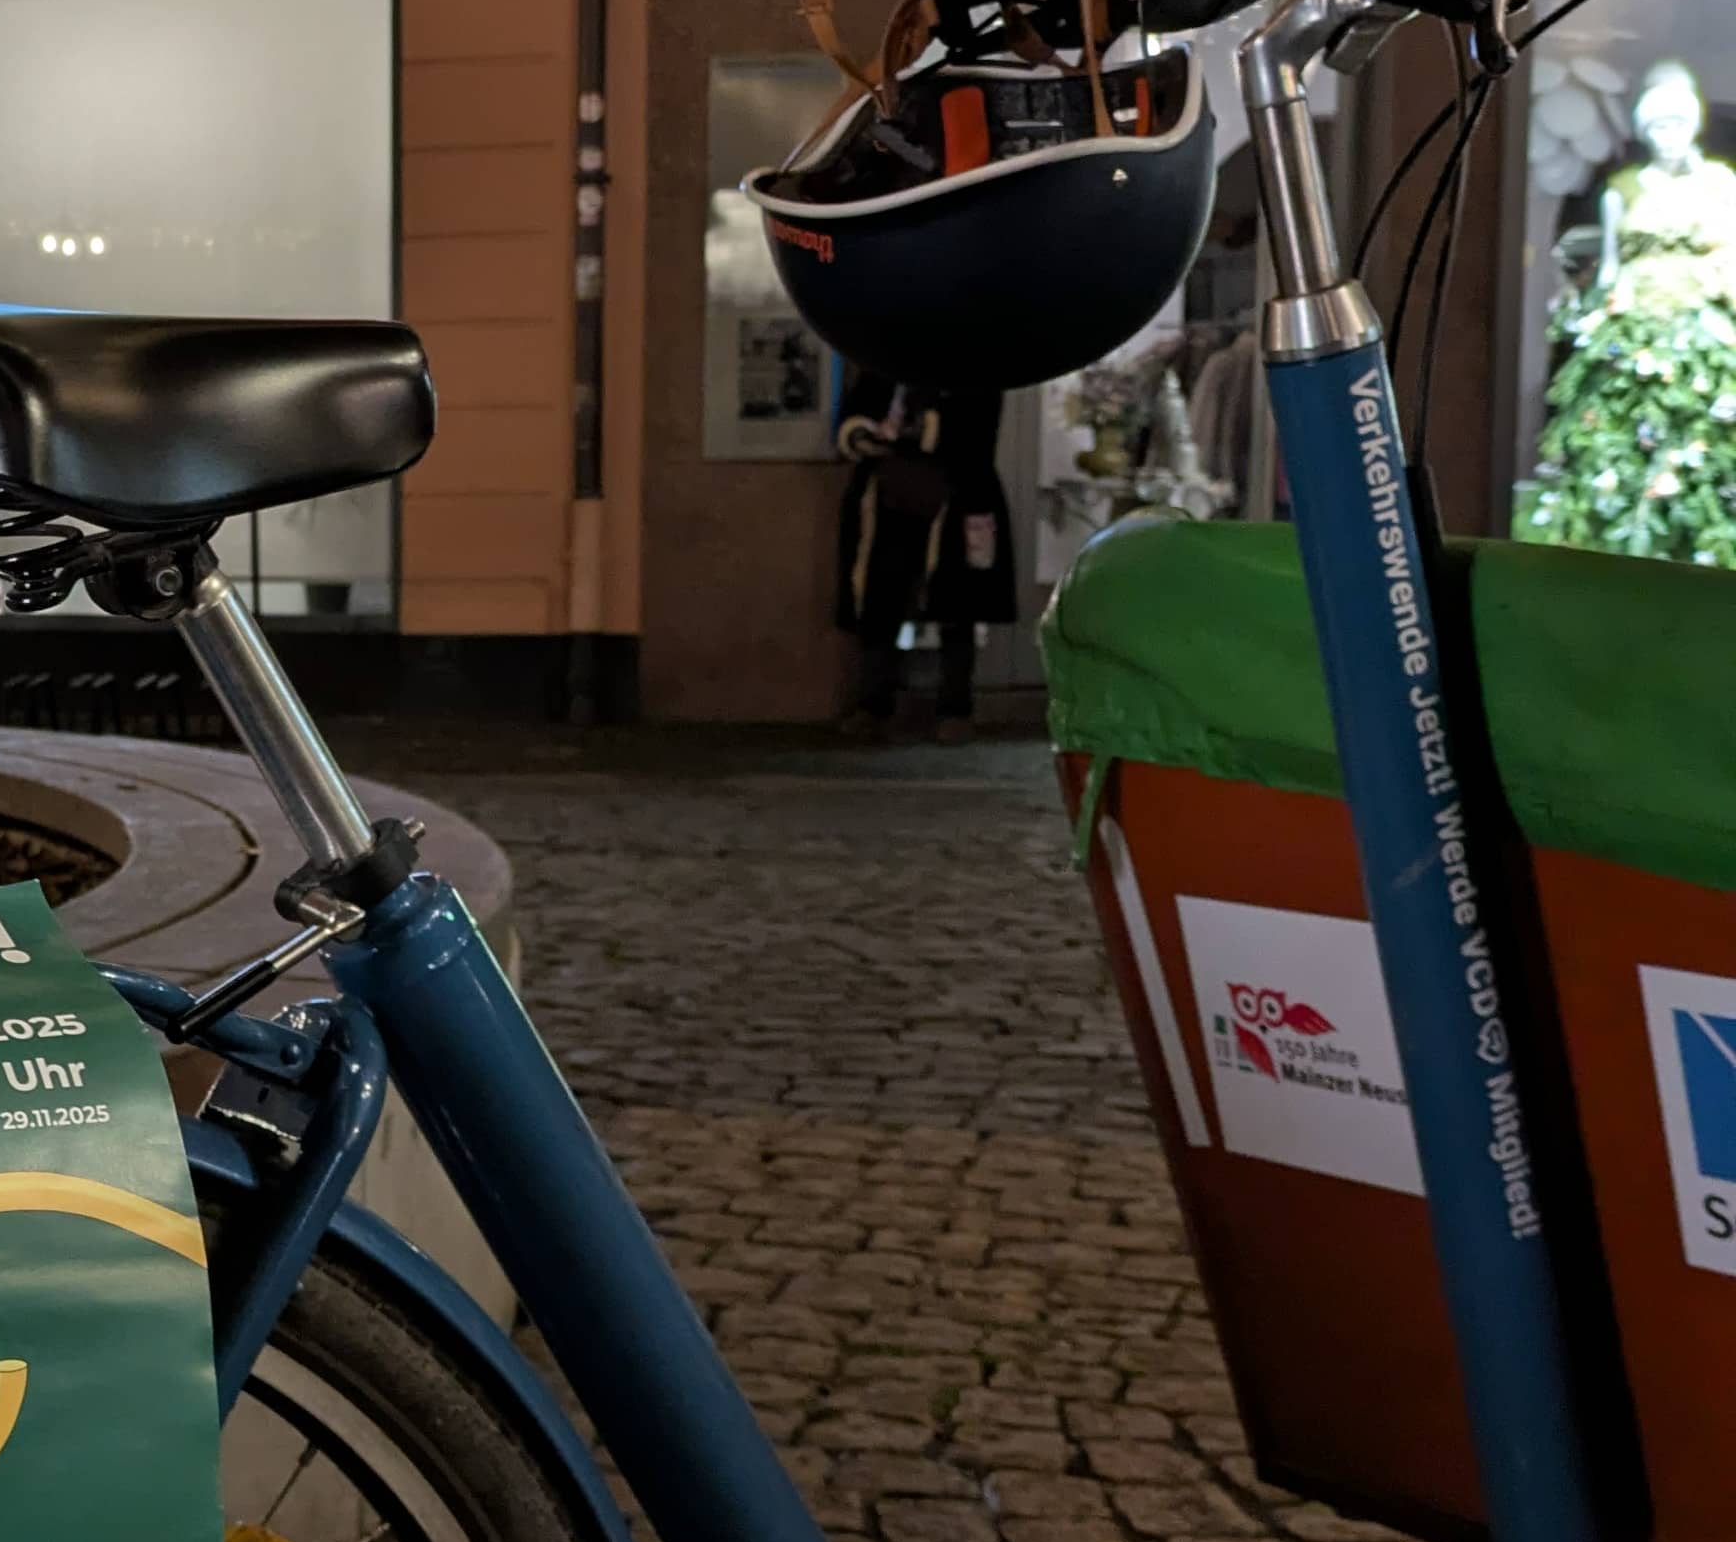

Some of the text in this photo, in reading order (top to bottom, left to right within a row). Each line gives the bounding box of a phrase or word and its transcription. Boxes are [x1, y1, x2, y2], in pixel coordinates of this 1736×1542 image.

[1348, 368, 1542, 1240] Verkehrswende Jetzt! Werde VCD Mitglied!
[2, 1057, 87, 1092] Uhr
[1359, 1077, 1408, 1105] Neus
[0, 1104, 111, 1131] 29.11.2025
[1702, 1194, 1736, 1240] S
